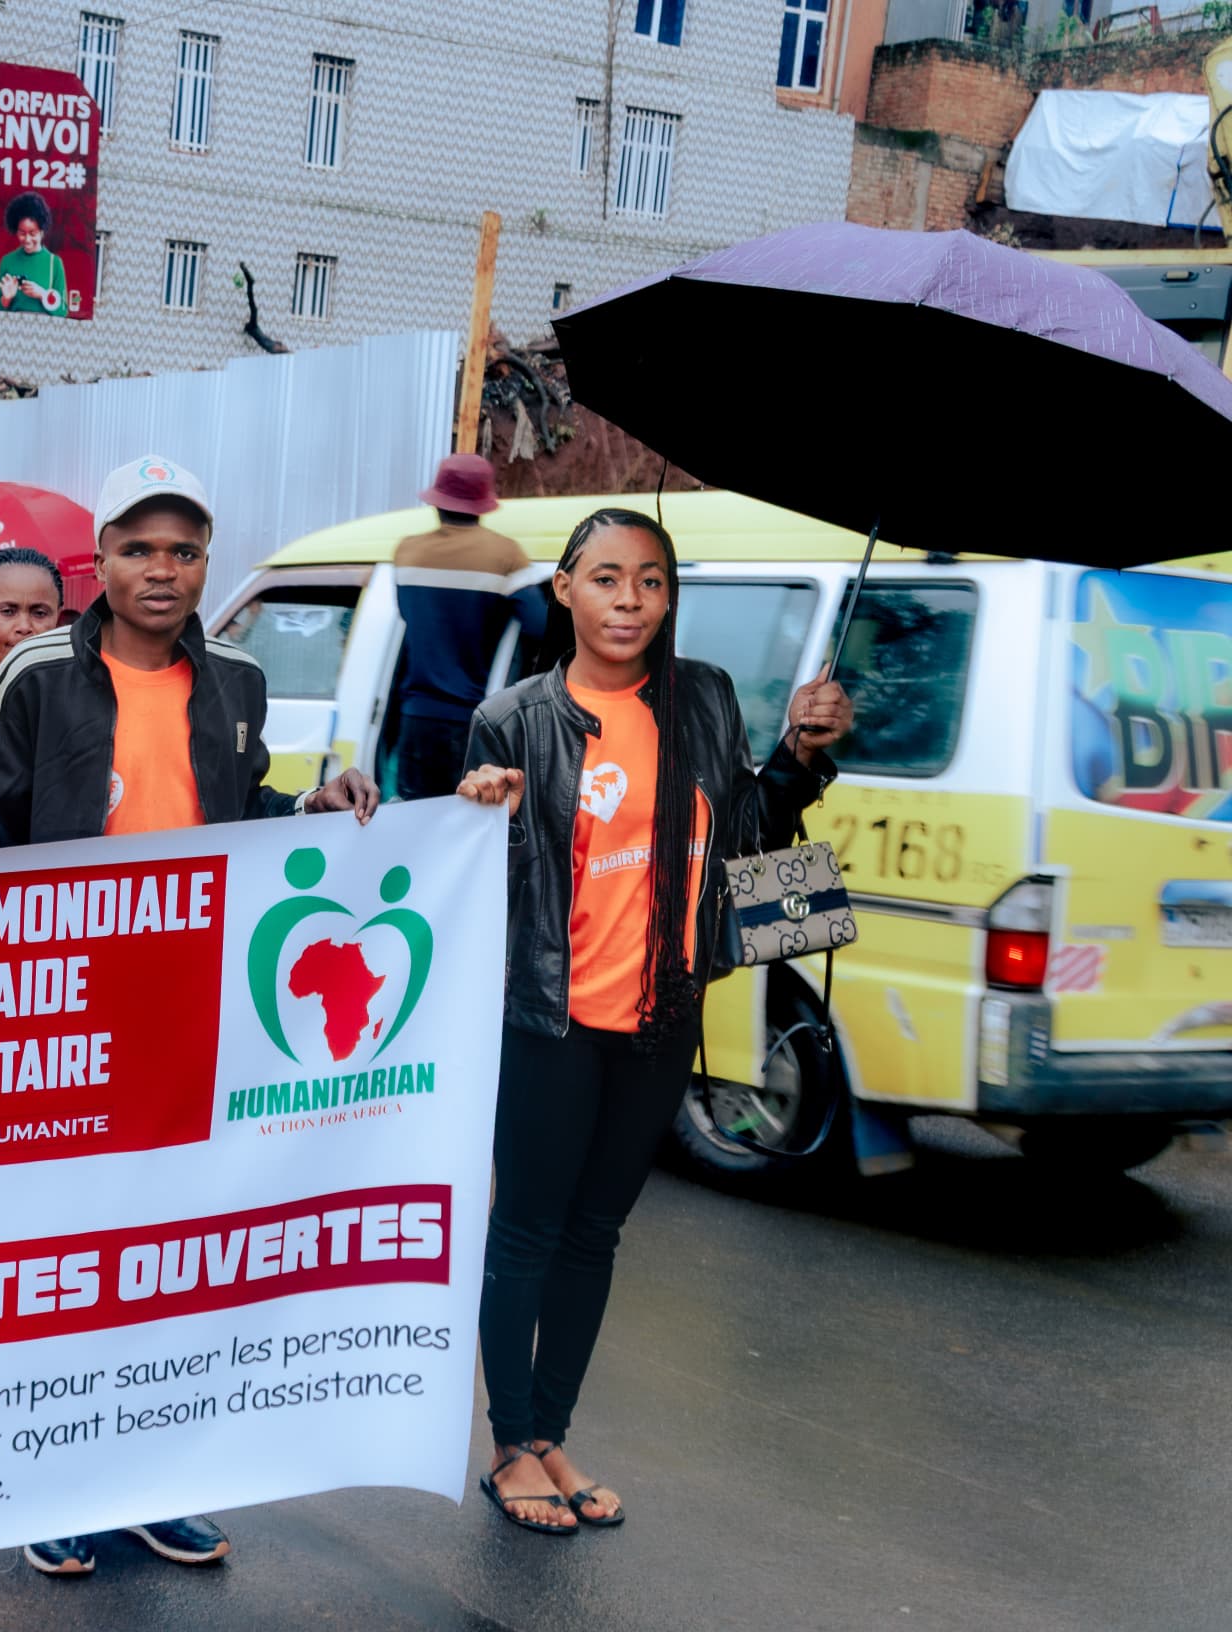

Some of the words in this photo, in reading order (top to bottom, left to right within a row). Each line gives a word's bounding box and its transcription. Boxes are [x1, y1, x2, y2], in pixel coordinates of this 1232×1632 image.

[832, 814, 966, 882] 2168
[227, 1062, 436, 1122] HUMANITARIAN
[257, 1118, 315, 1137] ACTION
[319, 1111, 347, 1127] FOR
[351, 1103, 402, 1121] AFRICA
[117, 1202, 444, 1303] OUVERTES
[29, 1368, 105, 1413] pour
[113, 1350, 222, 1390] sauver
[230, 1335, 273, 1368] les
[282, 1322, 453, 1370] personnes
[11, 1411, 106, 1460] ayant
[115, 1390, 218, 1436] besoin
[225, 1369, 425, 1414] d'assistance
